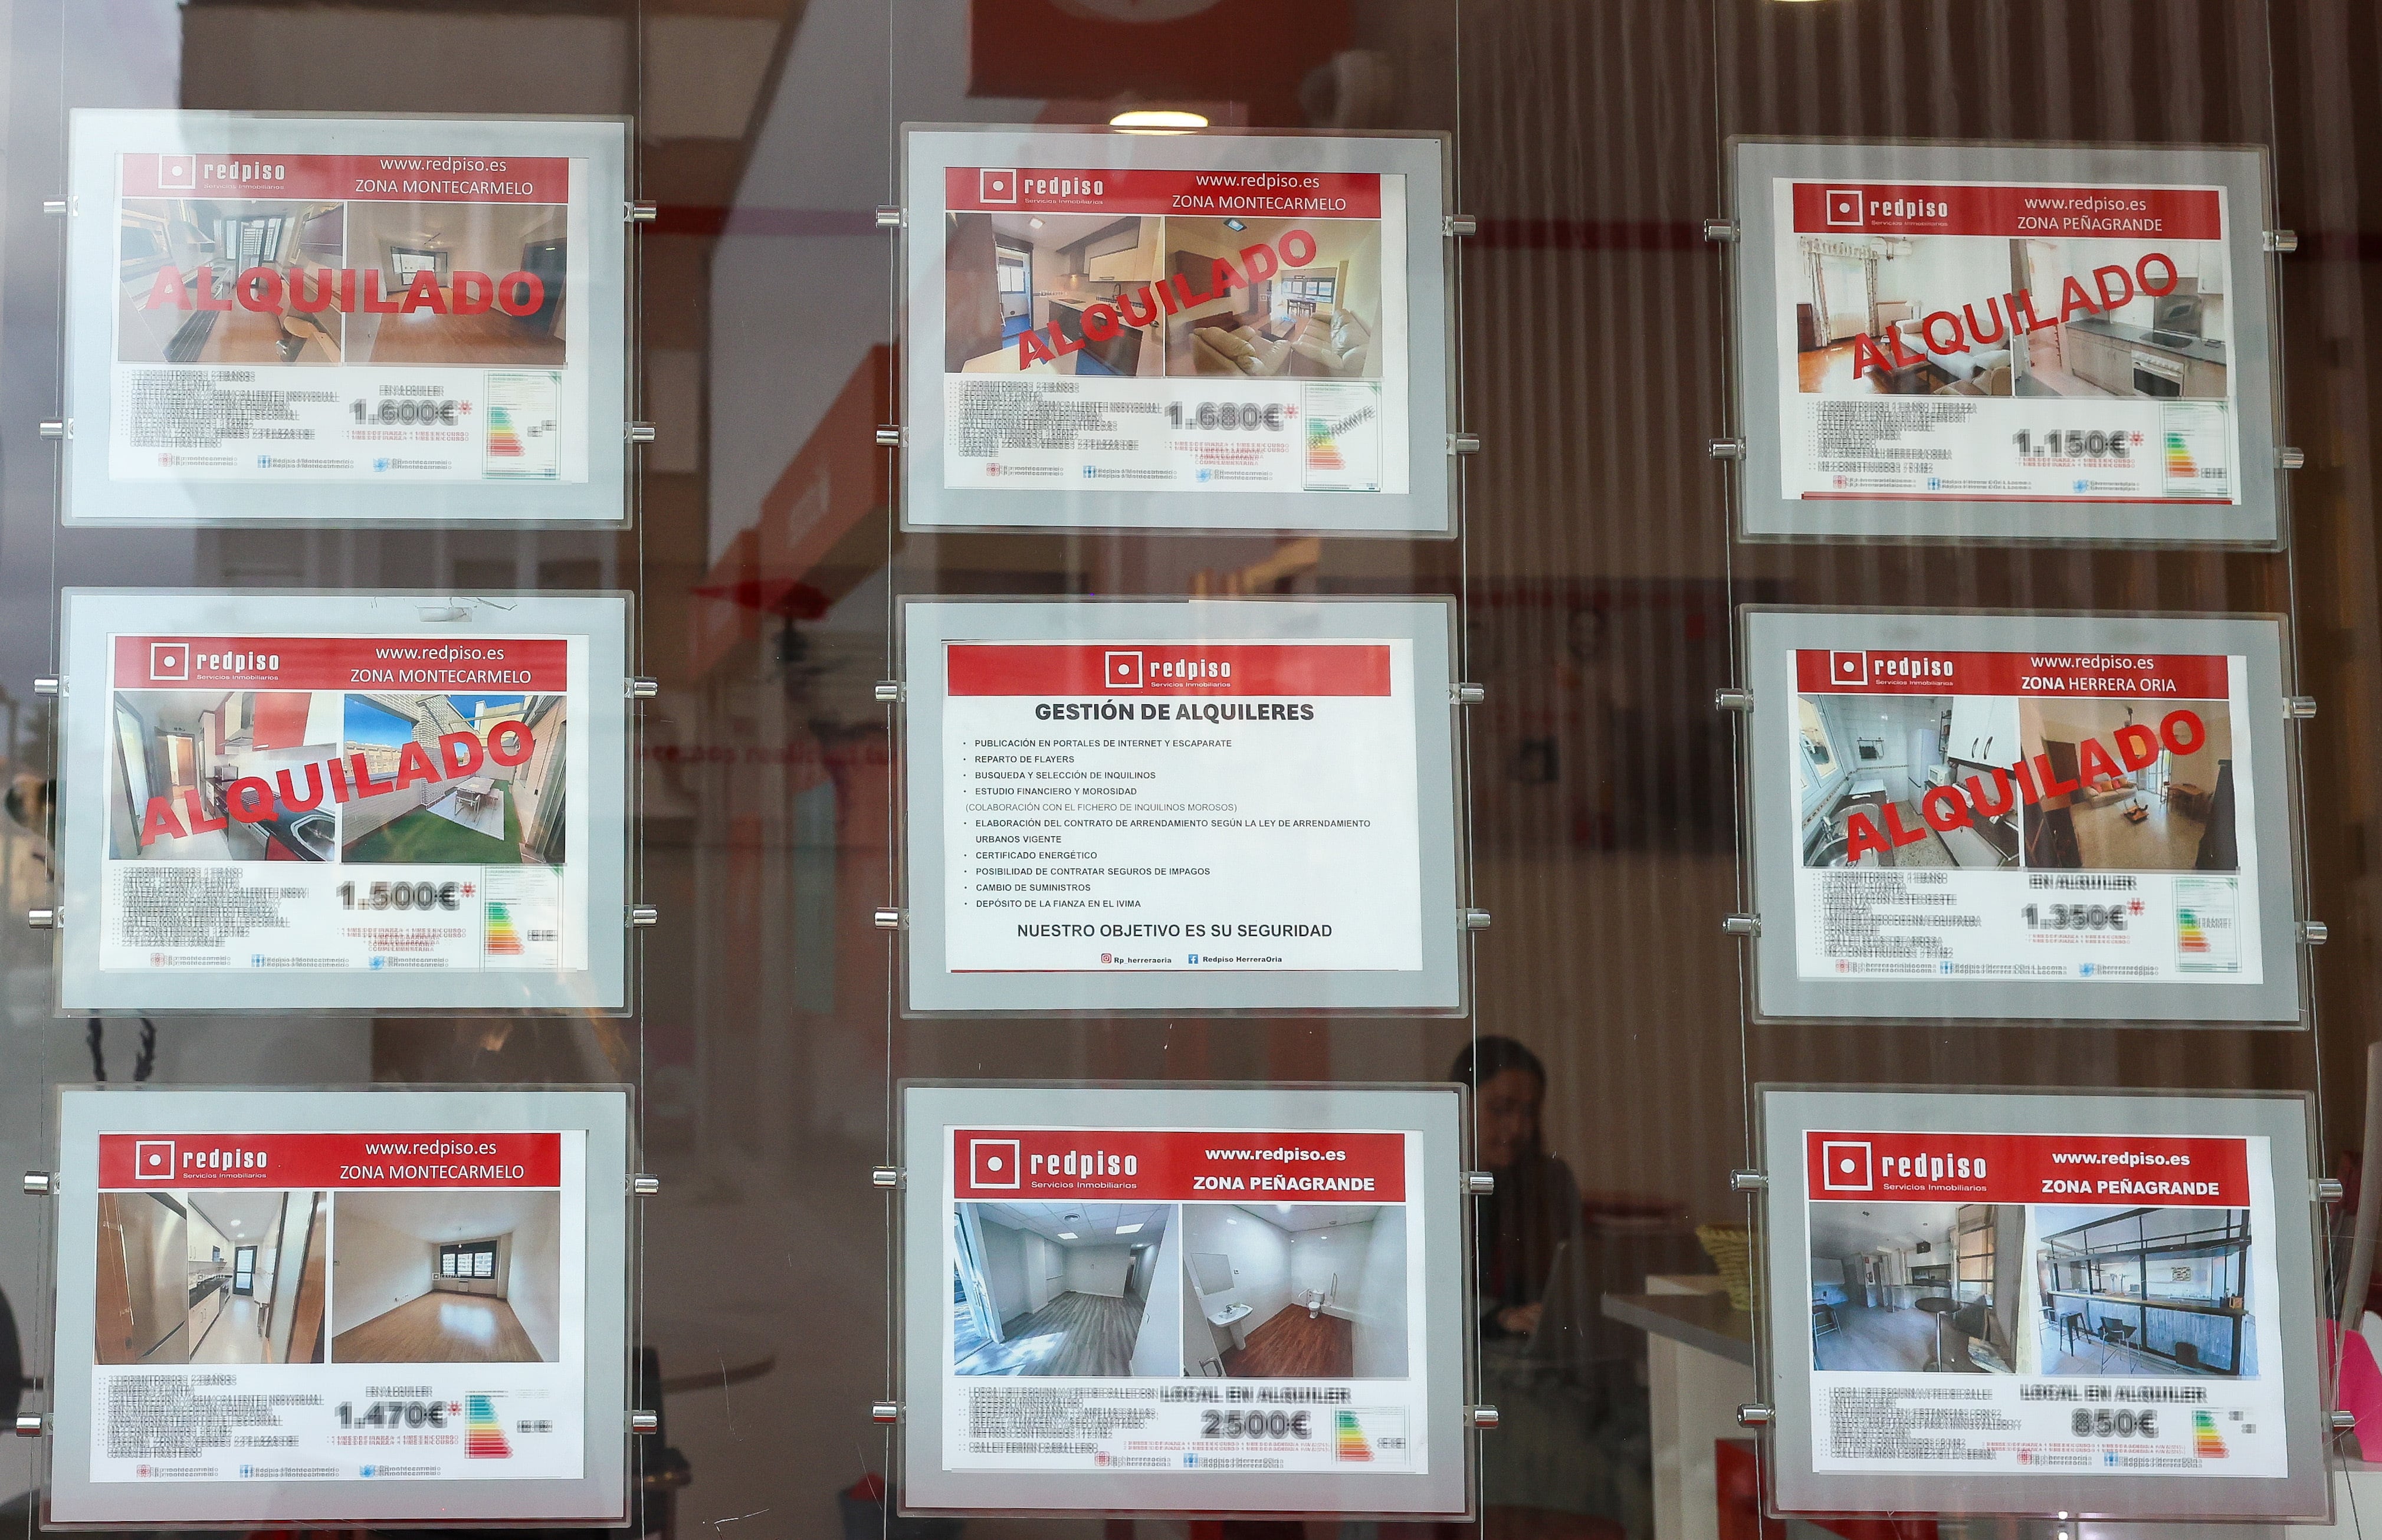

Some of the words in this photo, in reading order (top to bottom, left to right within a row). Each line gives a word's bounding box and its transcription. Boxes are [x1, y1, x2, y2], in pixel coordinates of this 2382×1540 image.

[204, 161, 285, 182] redpiso
[379, 156, 507, 174] www.redpiso.es
[355, 179, 398, 192] ZONA
[403, 180, 533, 195] MONTECARMELO
[1024, 176, 1103, 198] redpiso
[1196, 173, 1320, 190] www.redpiso.es
[1172, 195, 1215, 208] ZONA
[1219, 196, 1346, 211] MONTECARMELO
[1871, 199, 1947, 219] redpiso
[2024, 196, 2146, 213] www.redpiso.es
[2017, 216, 2059, 229] ZONA
[2063, 215, 2163, 231] PEÑAGRANDE
[145, 265, 545, 317] ALQUILADO
[1019, 229, 1317, 370] ALQUILADO
[1852, 252, 2178, 380] ALQUILADO
[197, 651, 278, 672] redpiso
[376, 645, 504, 663] www.redpiso.es
[2030, 654, 2155, 672] www.redpiso.es
[1150, 659, 1231, 681] redpiso
[1874, 656, 1953, 678] redpiso
[350, 669, 394, 682] ZONA
[399, 669, 531, 684] MONTECARMELO
[2021, 677, 2065, 690] ZONA
[2069, 677, 2136, 691] HERRERA
[2140, 678, 2177, 692] ORIA
[1035, 699, 1134, 720] GESTIÓN
[1141, 704, 1170, 720] DE
[1175, 703, 1314, 724] ALQUILERES
[975, 738, 1036, 747] PUBLICACIÓN
[140, 719, 534, 846] ALQUILADO
[1036, 770, 1087, 779] SELECCIÓN
[1104, 771, 1156, 780] INQUILINOS
[1847, 710, 2206, 862] ALQUILADO
[966, 802, 1040, 813] (COLABORACIÓN
[1134, 803, 1185, 812] INQUILINOS
[1187, 803, 1237, 813] MOROSOS)
[976, 817, 1041, 827] ELABORACIÓN
[1211, 818, 1242, 827] SEGÚN
[976, 851, 1036, 859] CERTIFICADO
[1039, 850, 1097, 859] ENERGÉTICO
[976, 898, 1022, 908] DEPÓSITO
[1018, 924, 1095, 937] NUESTRO
[1100, 924, 1180, 937] OBJETIVO
[1186, 924, 1206, 937] ES
[1211, 924, 1232, 937] SU
[1238, 924, 1332, 937] SEGURIDAD
[365, 1139, 497, 1158] www.redpiso.es
[1205, 1147, 1346, 1163] www.redpiso.es
[182, 1148, 268, 1171] redpiso
[1031, 1150, 1137, 1178] redpiso
[1882, 1153, 1987, 1181] redpiso
[2052, 1151, 2190, 1168] www.redpiso.es
[340, 1165, 385, 1179] ZONA
[389, 1165, 524, 1179] MONTECARMELO
[1193, 1176, 1245, 1190] ZONA
[1250, 1174, 1375, 1191] PEÑAGRANDE
[2042, 1180, 2092, 1193] ZONA
[2097, 1178, 2220, 1196] PEÑAGRANDE
